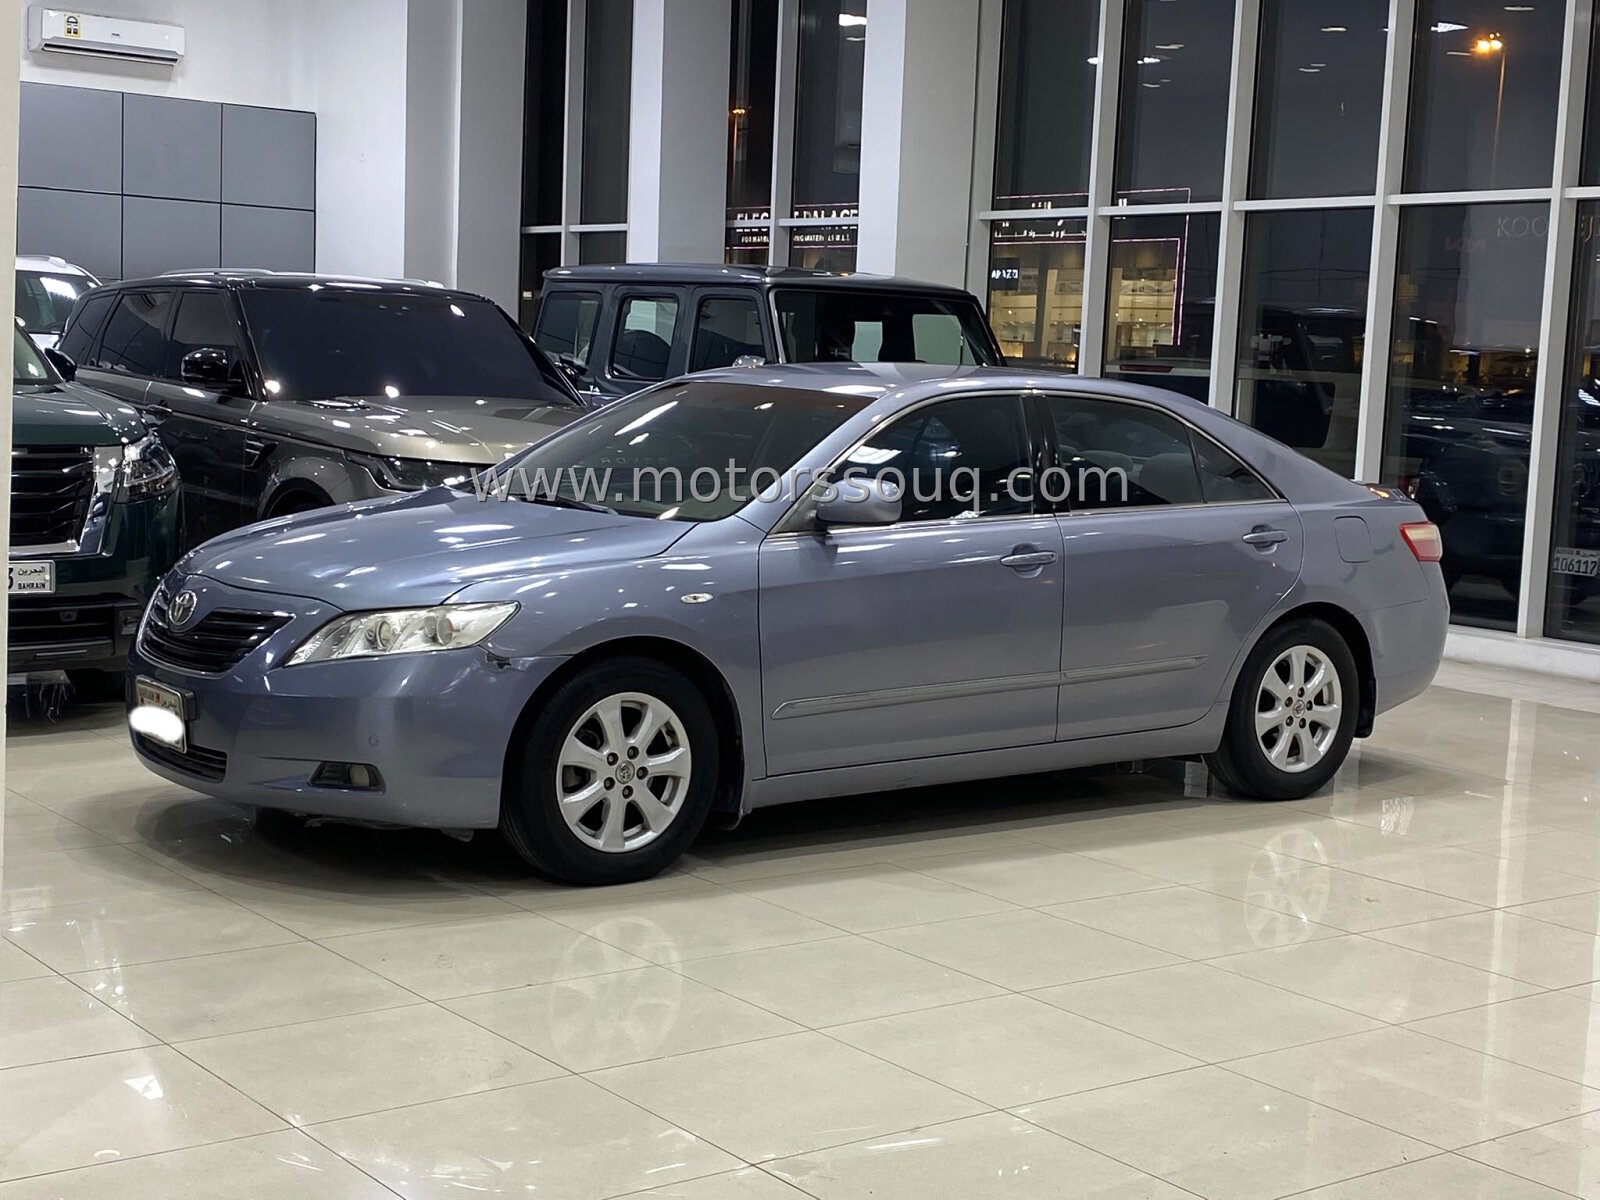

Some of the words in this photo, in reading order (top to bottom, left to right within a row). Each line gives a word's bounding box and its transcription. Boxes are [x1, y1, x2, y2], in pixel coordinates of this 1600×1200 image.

[17, 565, 46, 576] البحرين
[1552, 557, 1598, 575] 106117
[18, 582, 46, 590] BAHRAIN
